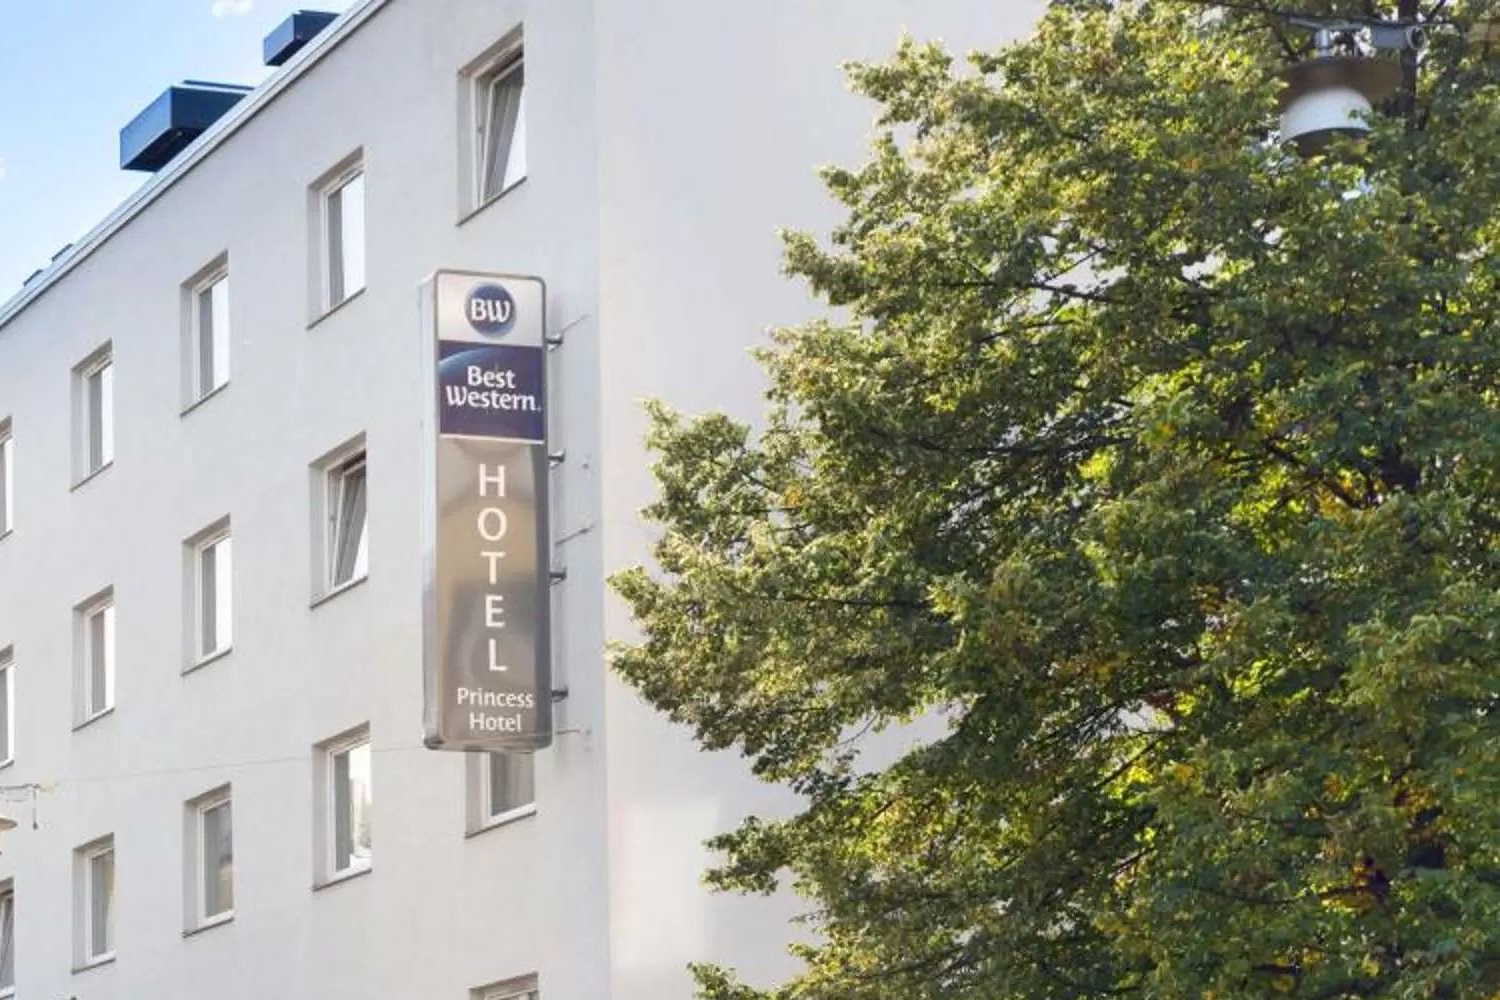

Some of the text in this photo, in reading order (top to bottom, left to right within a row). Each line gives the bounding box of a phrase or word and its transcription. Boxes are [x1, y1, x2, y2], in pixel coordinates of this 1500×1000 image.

[470, 298, 511, 323] BW
[467, 365, 517, 389] Best
[445, 384, 541, 412] Western
[477, 463, 508, 672] HOTEL
[456, 686, 535, 710] Princess
[468, 712, 522, 733] Hotel
